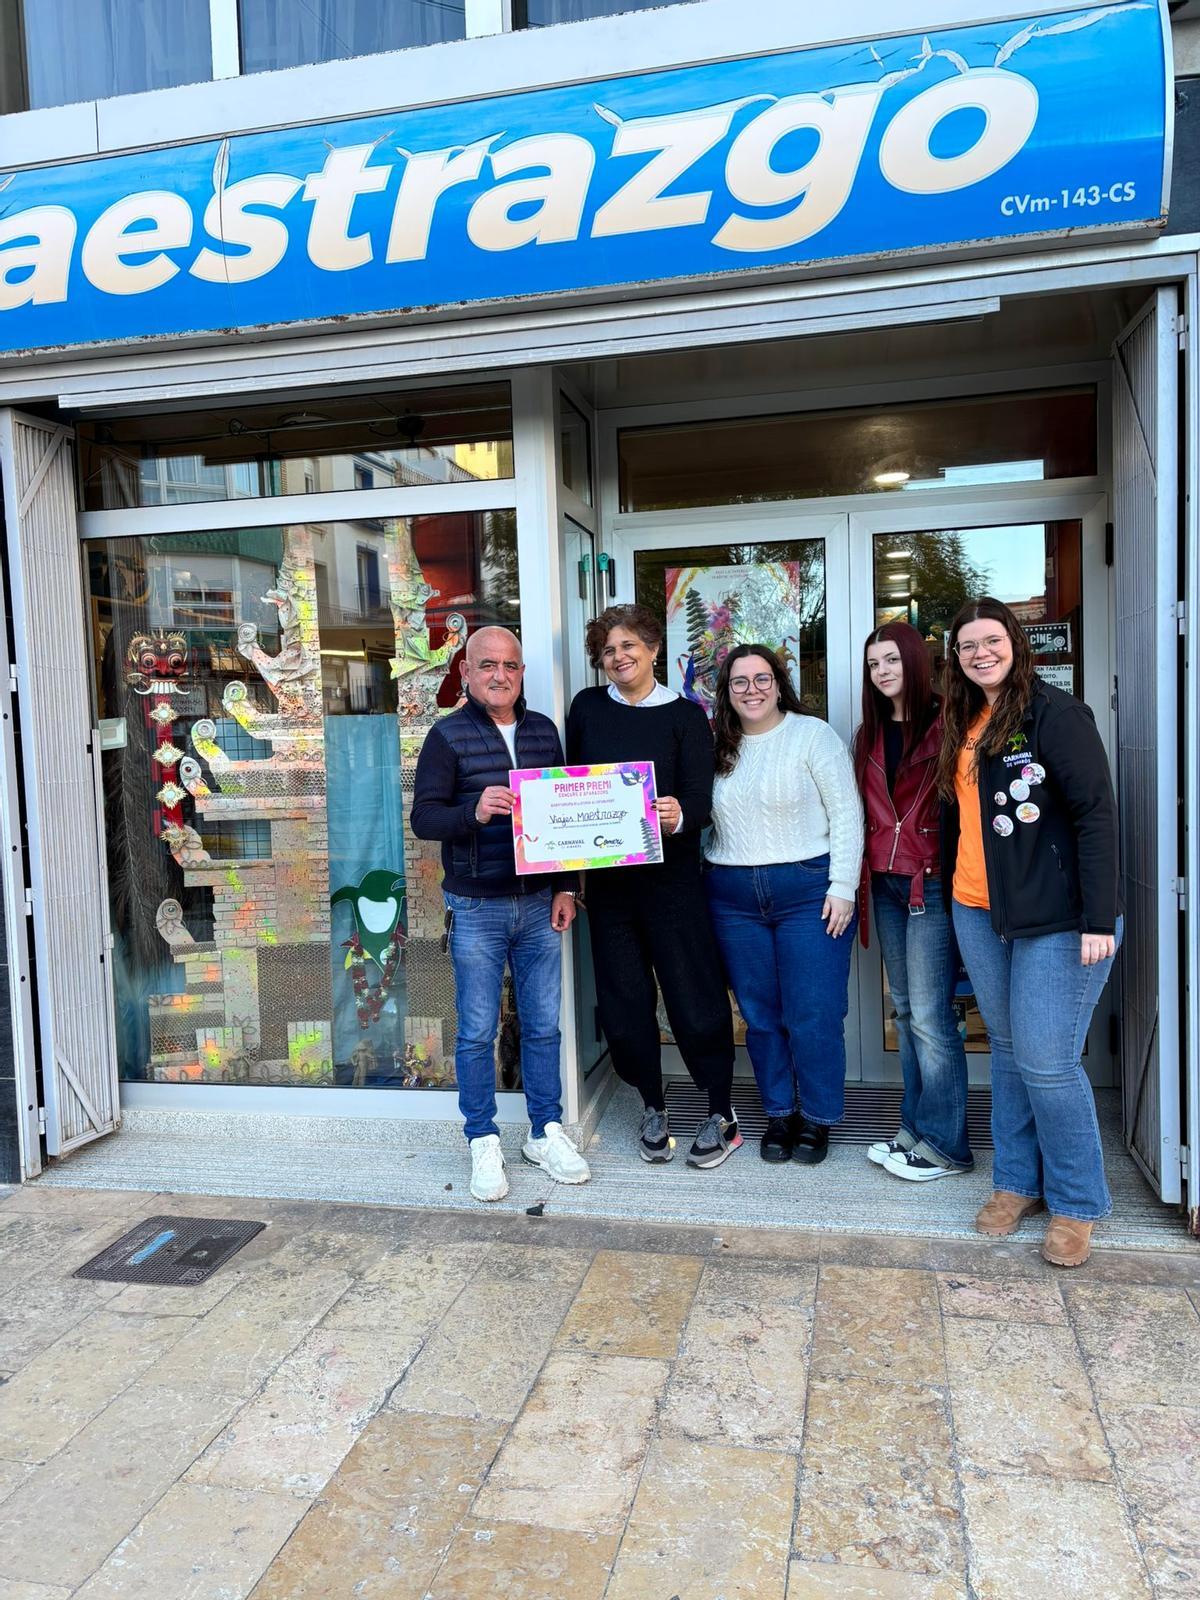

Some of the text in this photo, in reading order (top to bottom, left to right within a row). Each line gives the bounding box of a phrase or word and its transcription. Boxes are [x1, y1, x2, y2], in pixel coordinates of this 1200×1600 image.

[0, 66, 1040, 312] aestrazgo
[1000, 181, 1136, 216] CVm-143-CS
[1029, 633, 1052, 645] CINE
[1002, 752, 1032, 762] CARNAVAL
[554, 780, 612, 793] PRIMER PREMI
[549, 814, 574, 827] Viajes
